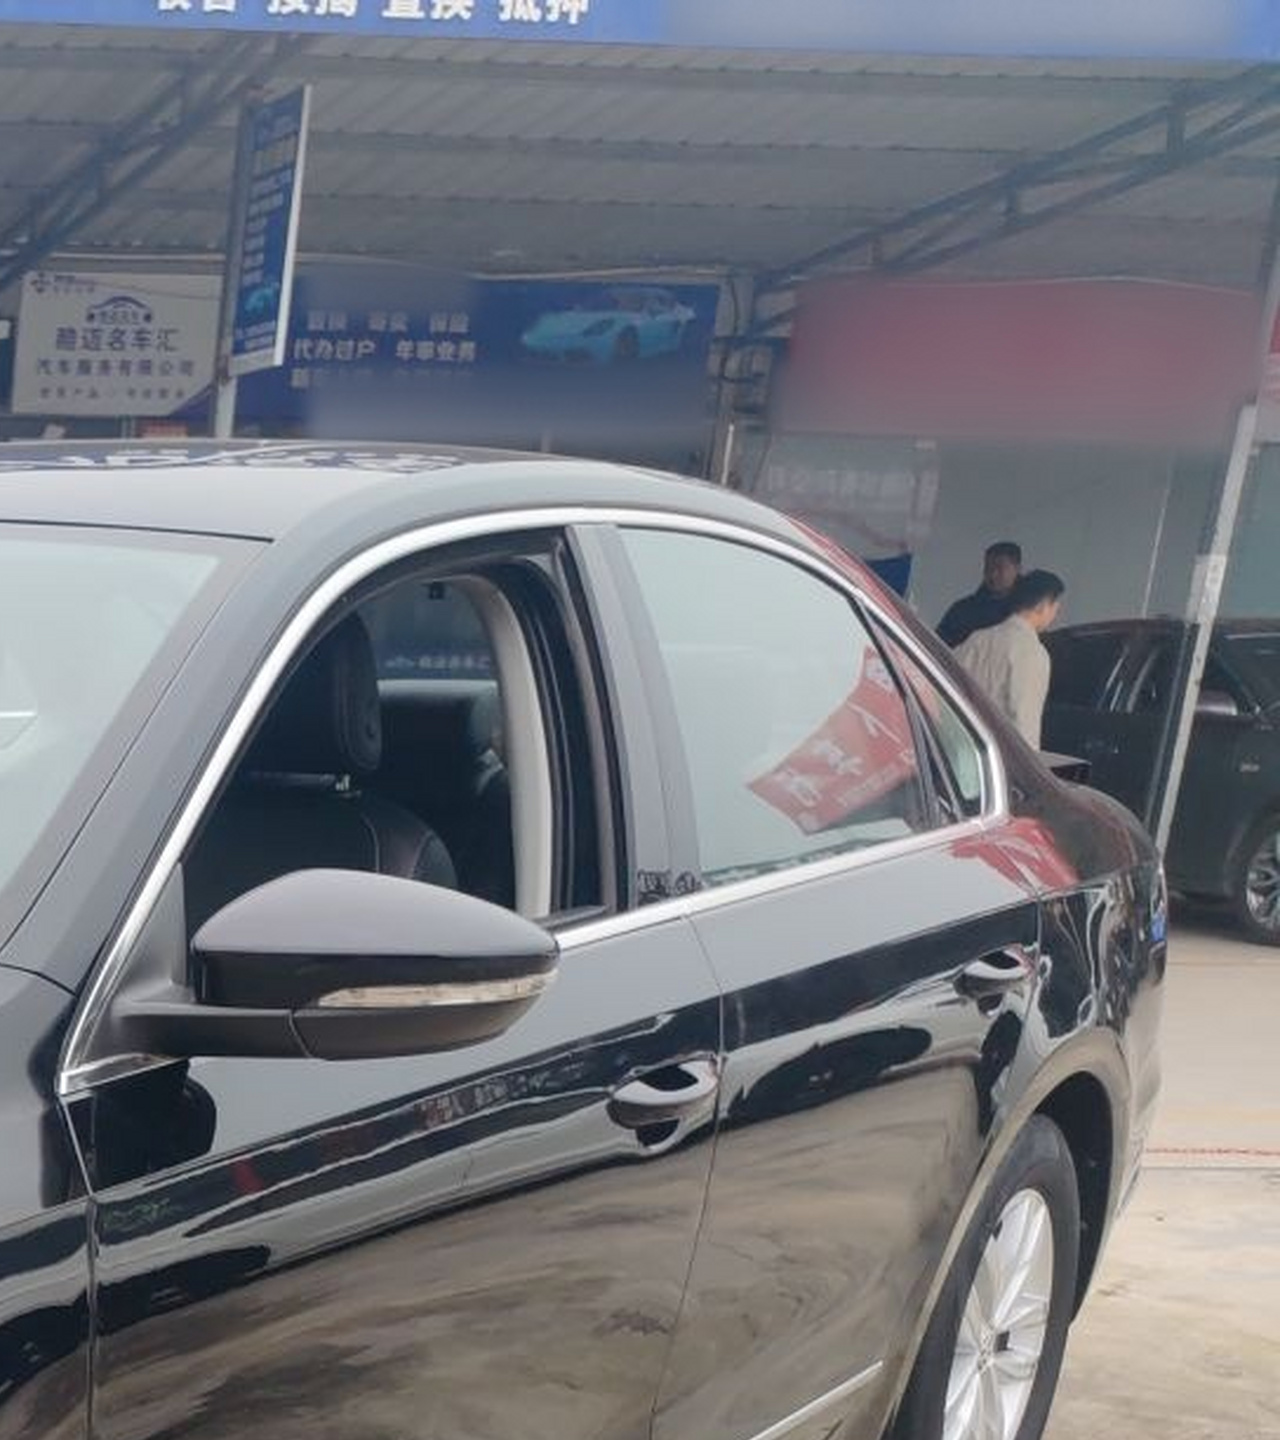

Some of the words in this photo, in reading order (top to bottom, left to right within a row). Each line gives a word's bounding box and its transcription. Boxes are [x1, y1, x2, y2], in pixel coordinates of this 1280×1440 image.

[293, 338, 376, 362] 代办过户
[39, 358, 195, 376] 汽车服务有限公司
